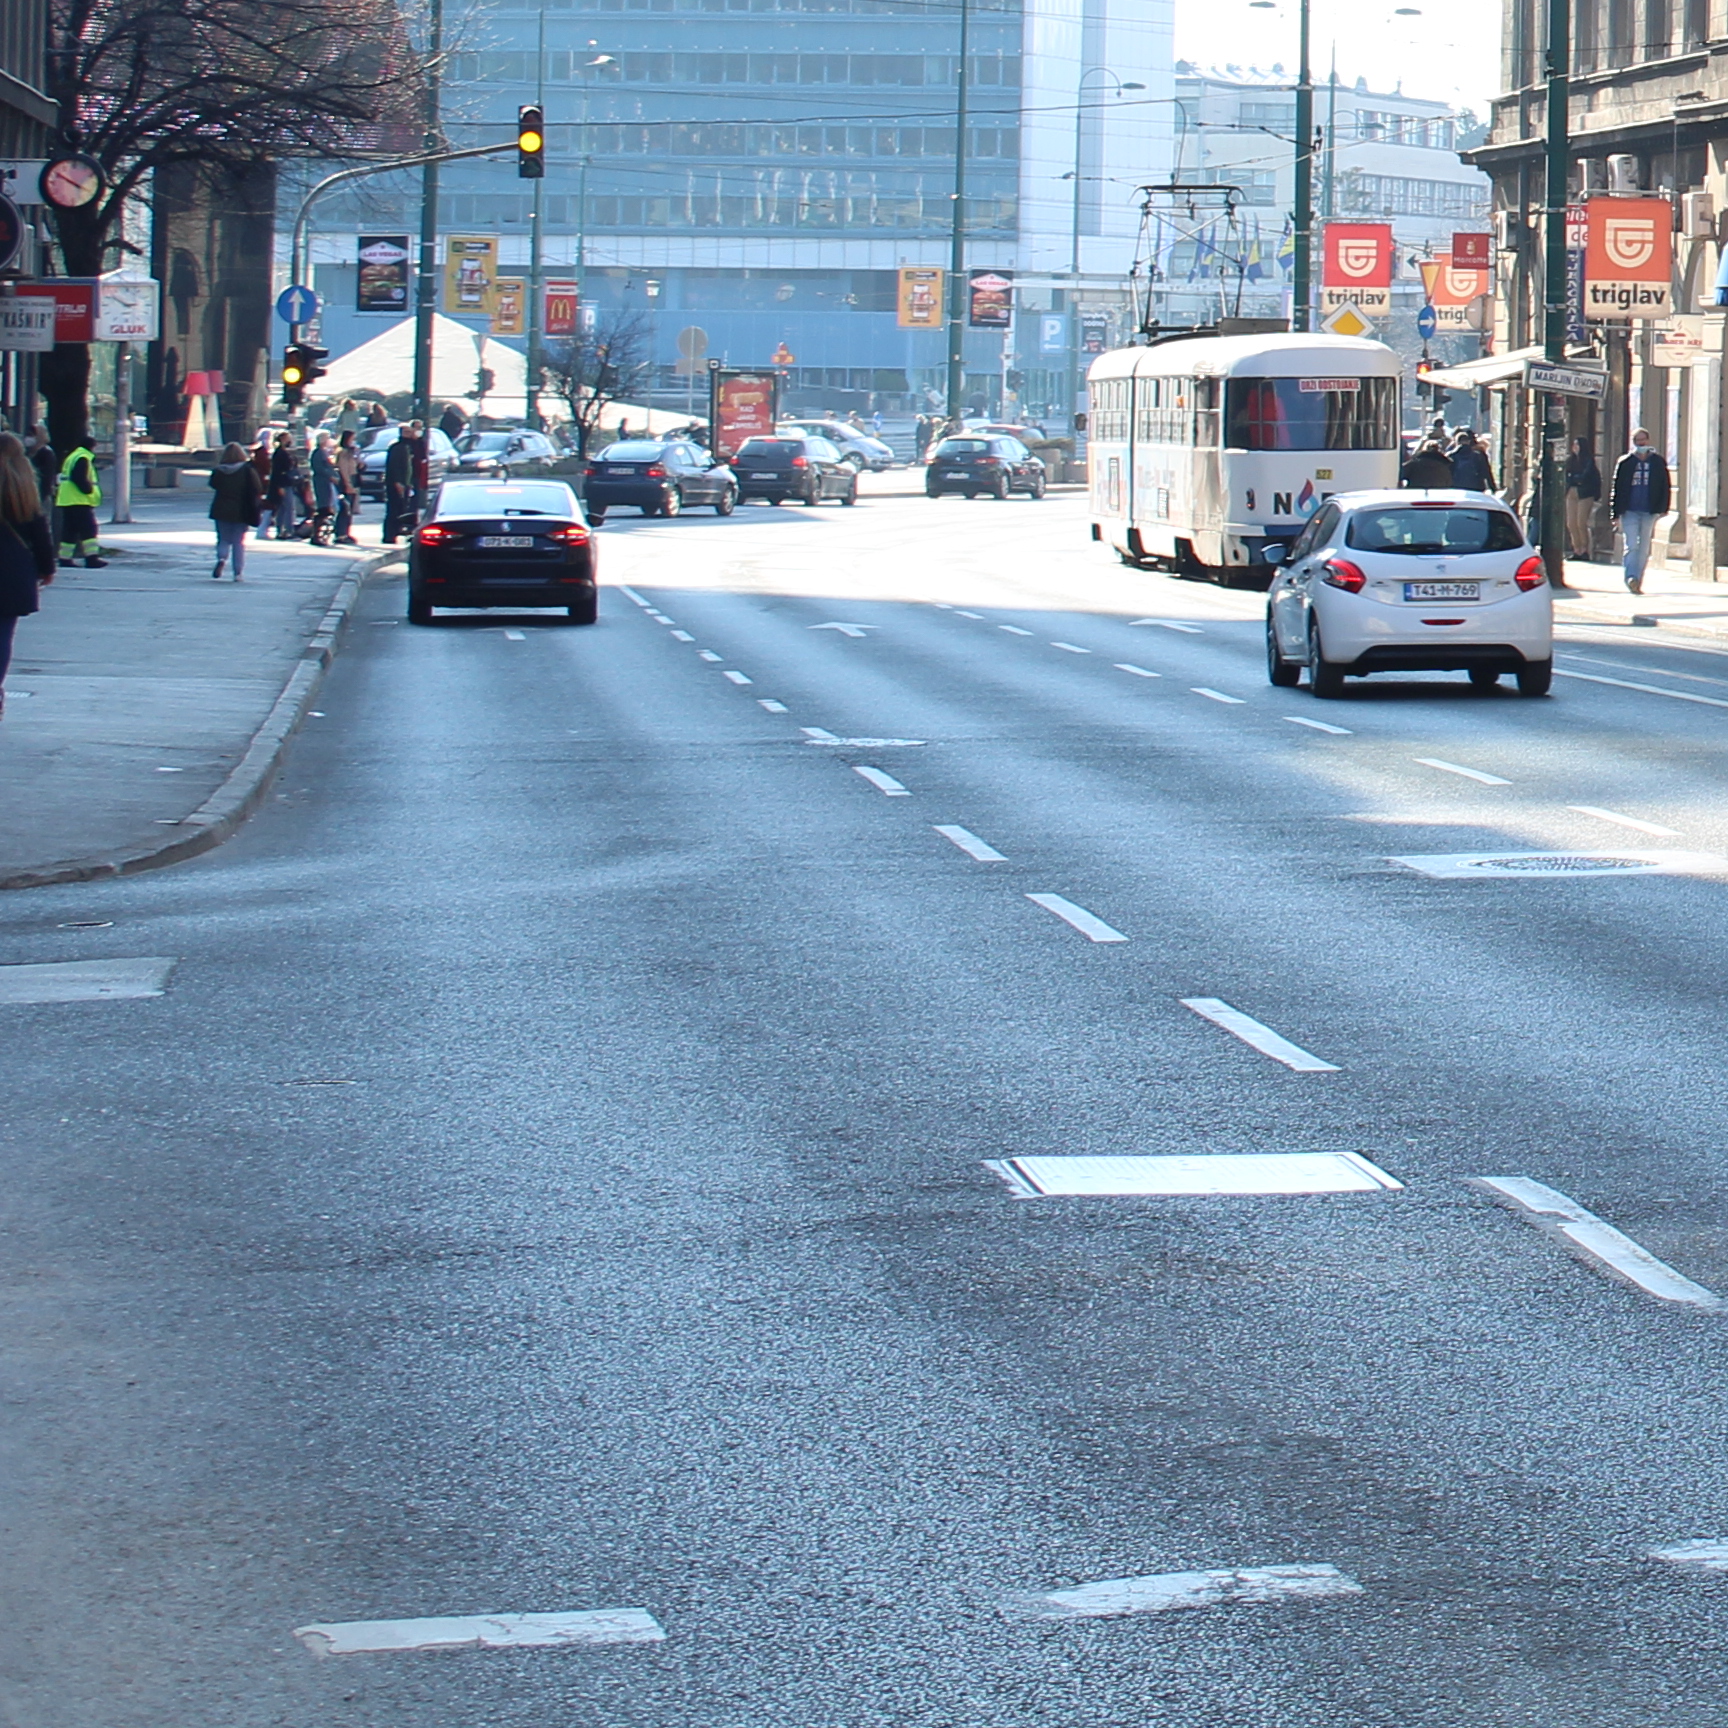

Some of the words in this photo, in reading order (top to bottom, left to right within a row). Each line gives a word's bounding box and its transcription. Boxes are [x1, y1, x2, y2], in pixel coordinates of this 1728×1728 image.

[1326, 287, 1387, 310] triglav
[1590, 283, 1666, 310] triglav
[1043, 320, 1062, 340] P
[1534, 370, 1572, 386] MARIJIN
[1413, 584, 1478, 596] T41-M-769
